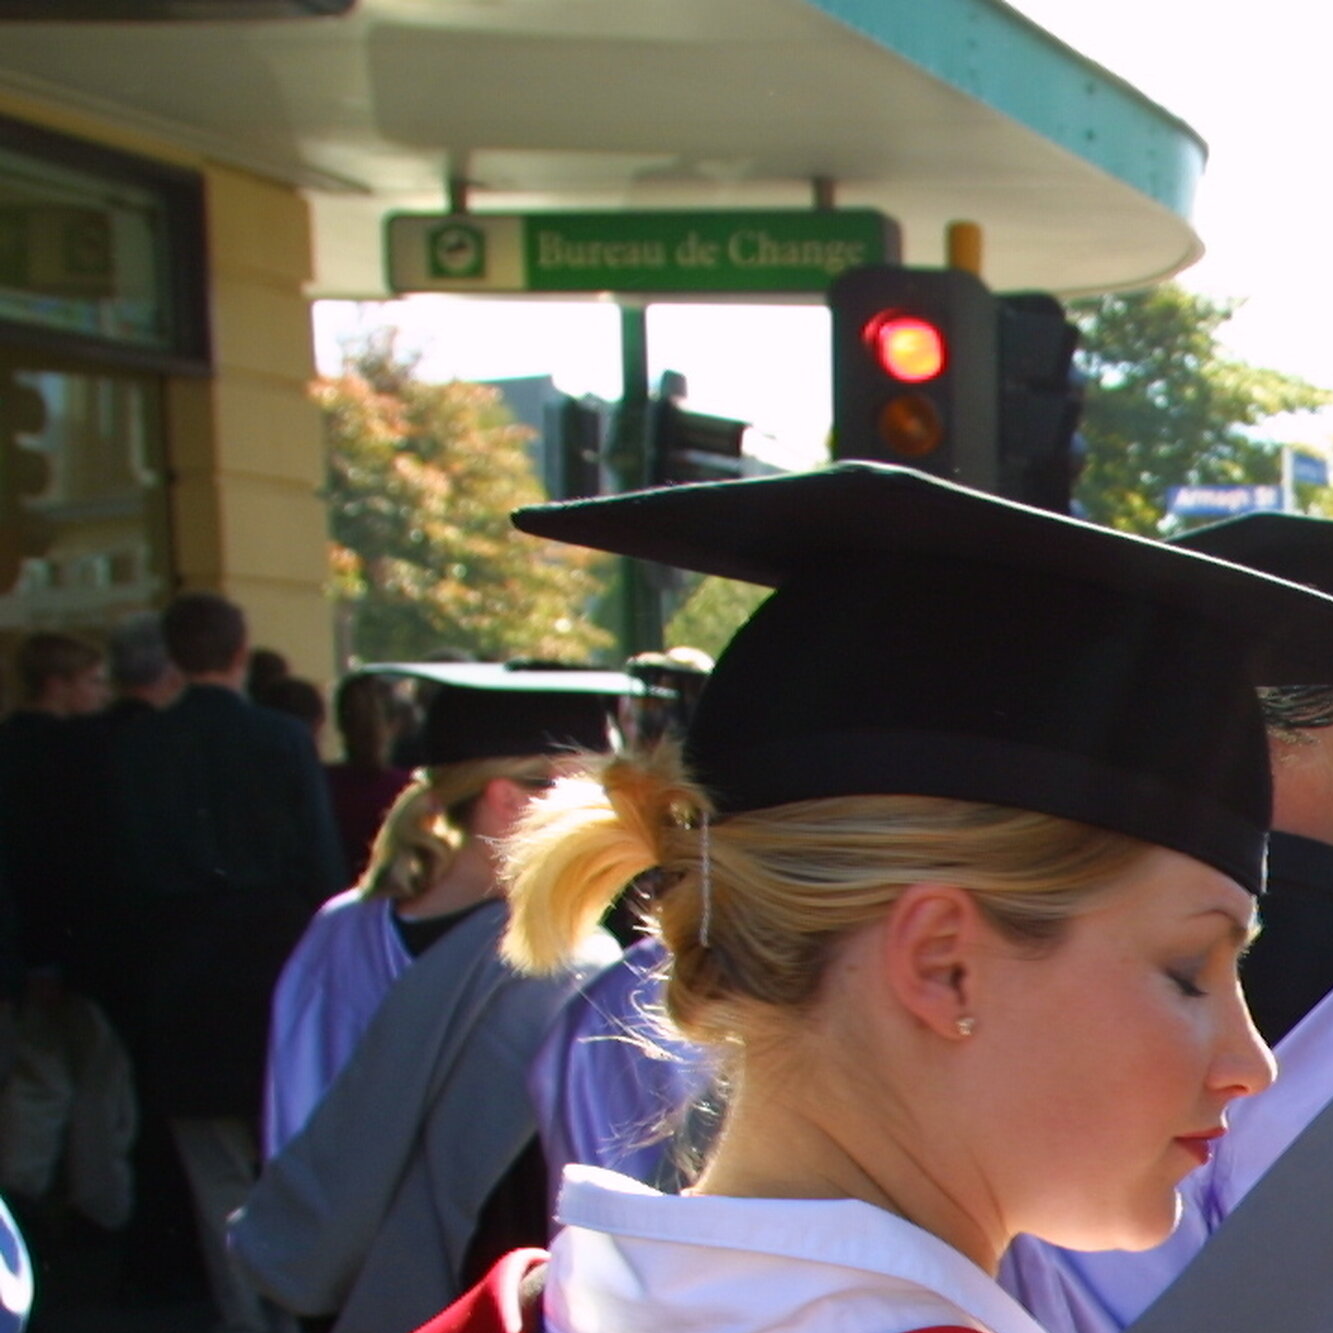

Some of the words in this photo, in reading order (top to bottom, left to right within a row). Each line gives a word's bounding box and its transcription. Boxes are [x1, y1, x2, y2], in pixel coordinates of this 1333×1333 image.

[538, 231, 666, 267] Bureau
[676, 230, 717, 267] de
[729, 229, 866, 274] Change
